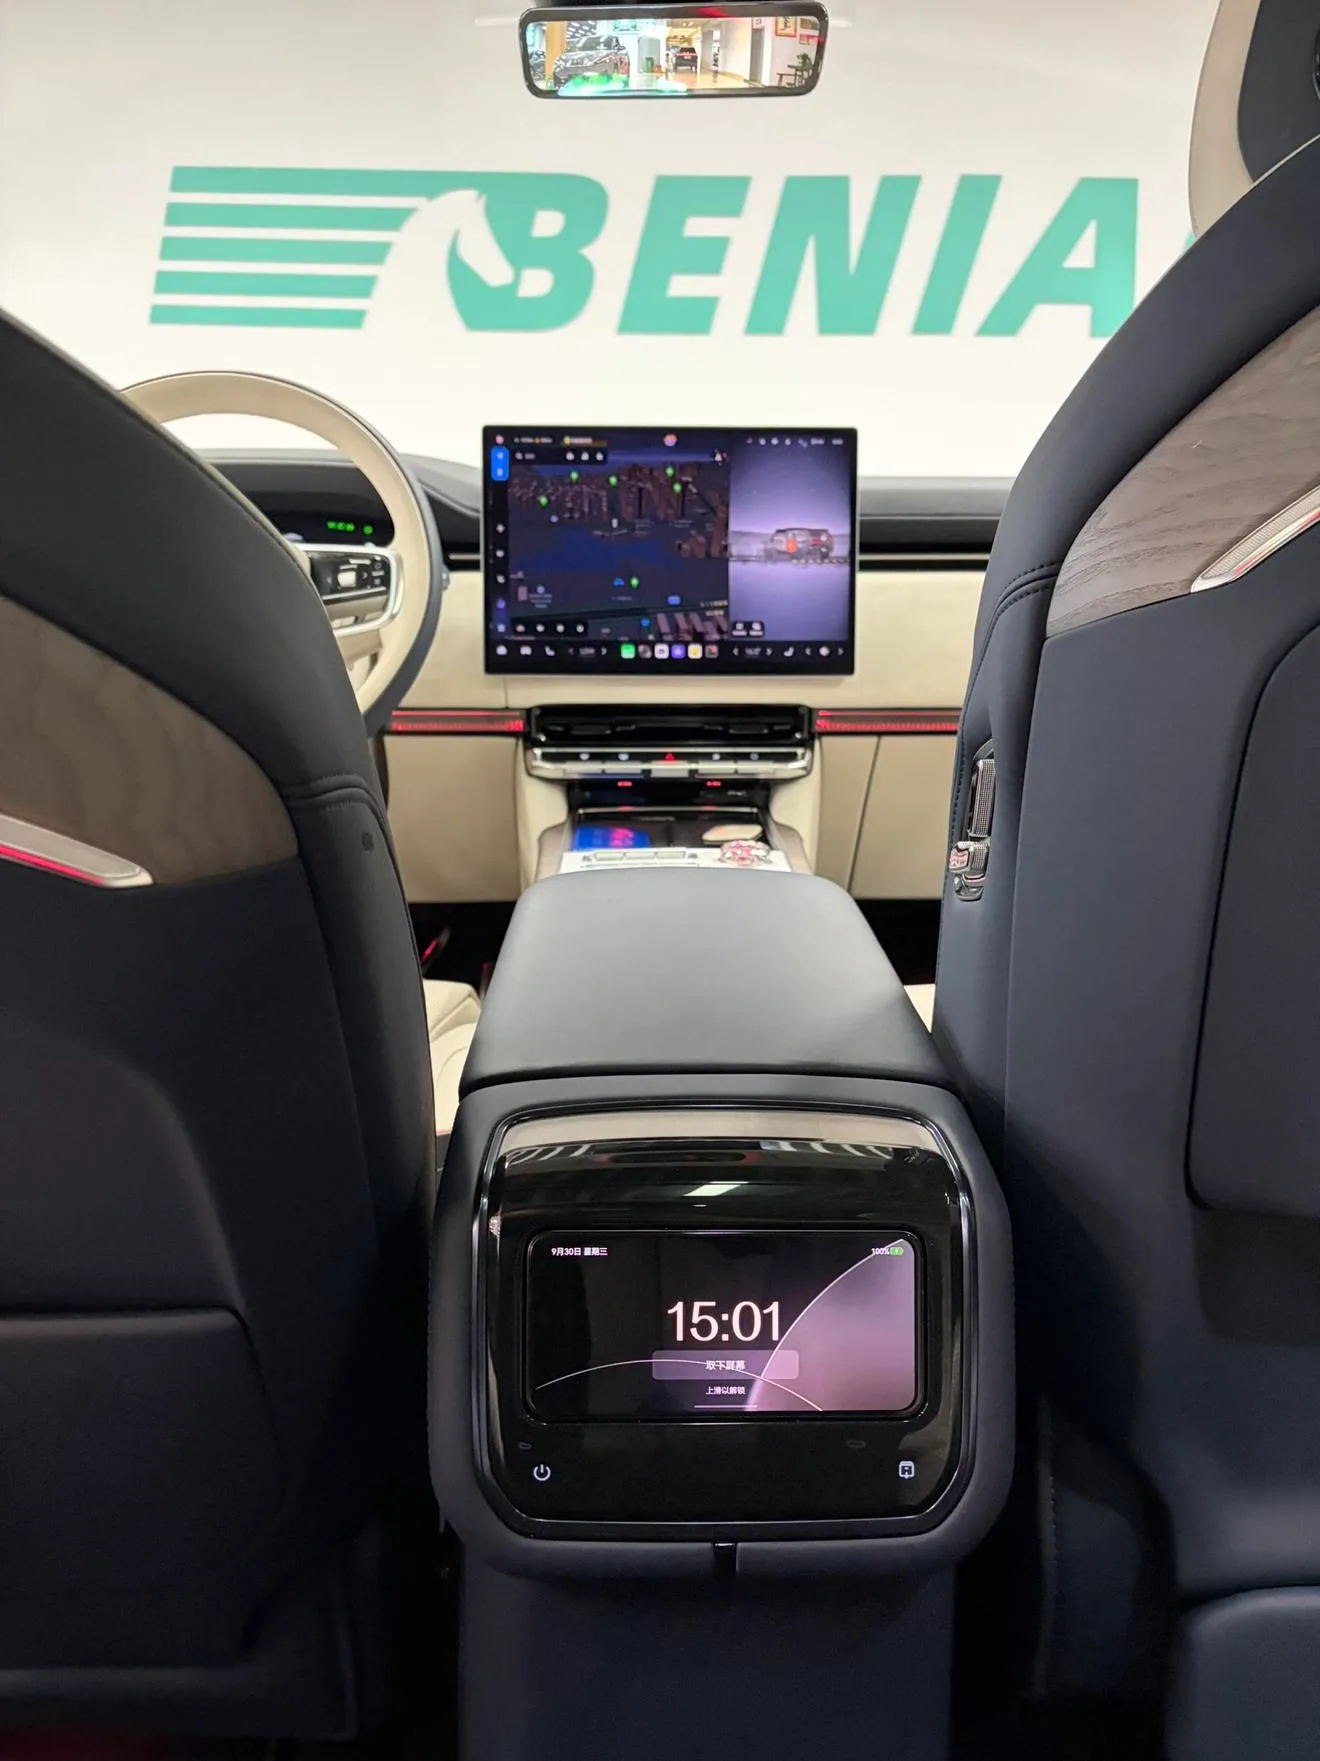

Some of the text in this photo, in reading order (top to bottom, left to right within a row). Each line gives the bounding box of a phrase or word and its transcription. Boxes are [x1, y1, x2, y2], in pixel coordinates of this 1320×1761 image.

[447, 171, 1197, 337] BENIA
[551, 1247, 582, 1256] 9月30日
[667, 1300, 780, 1342] 15:01
[705, 1360, 746, 1370] 取下屏幕
[705, 1386, 746, 1395] 上滑以解锁
